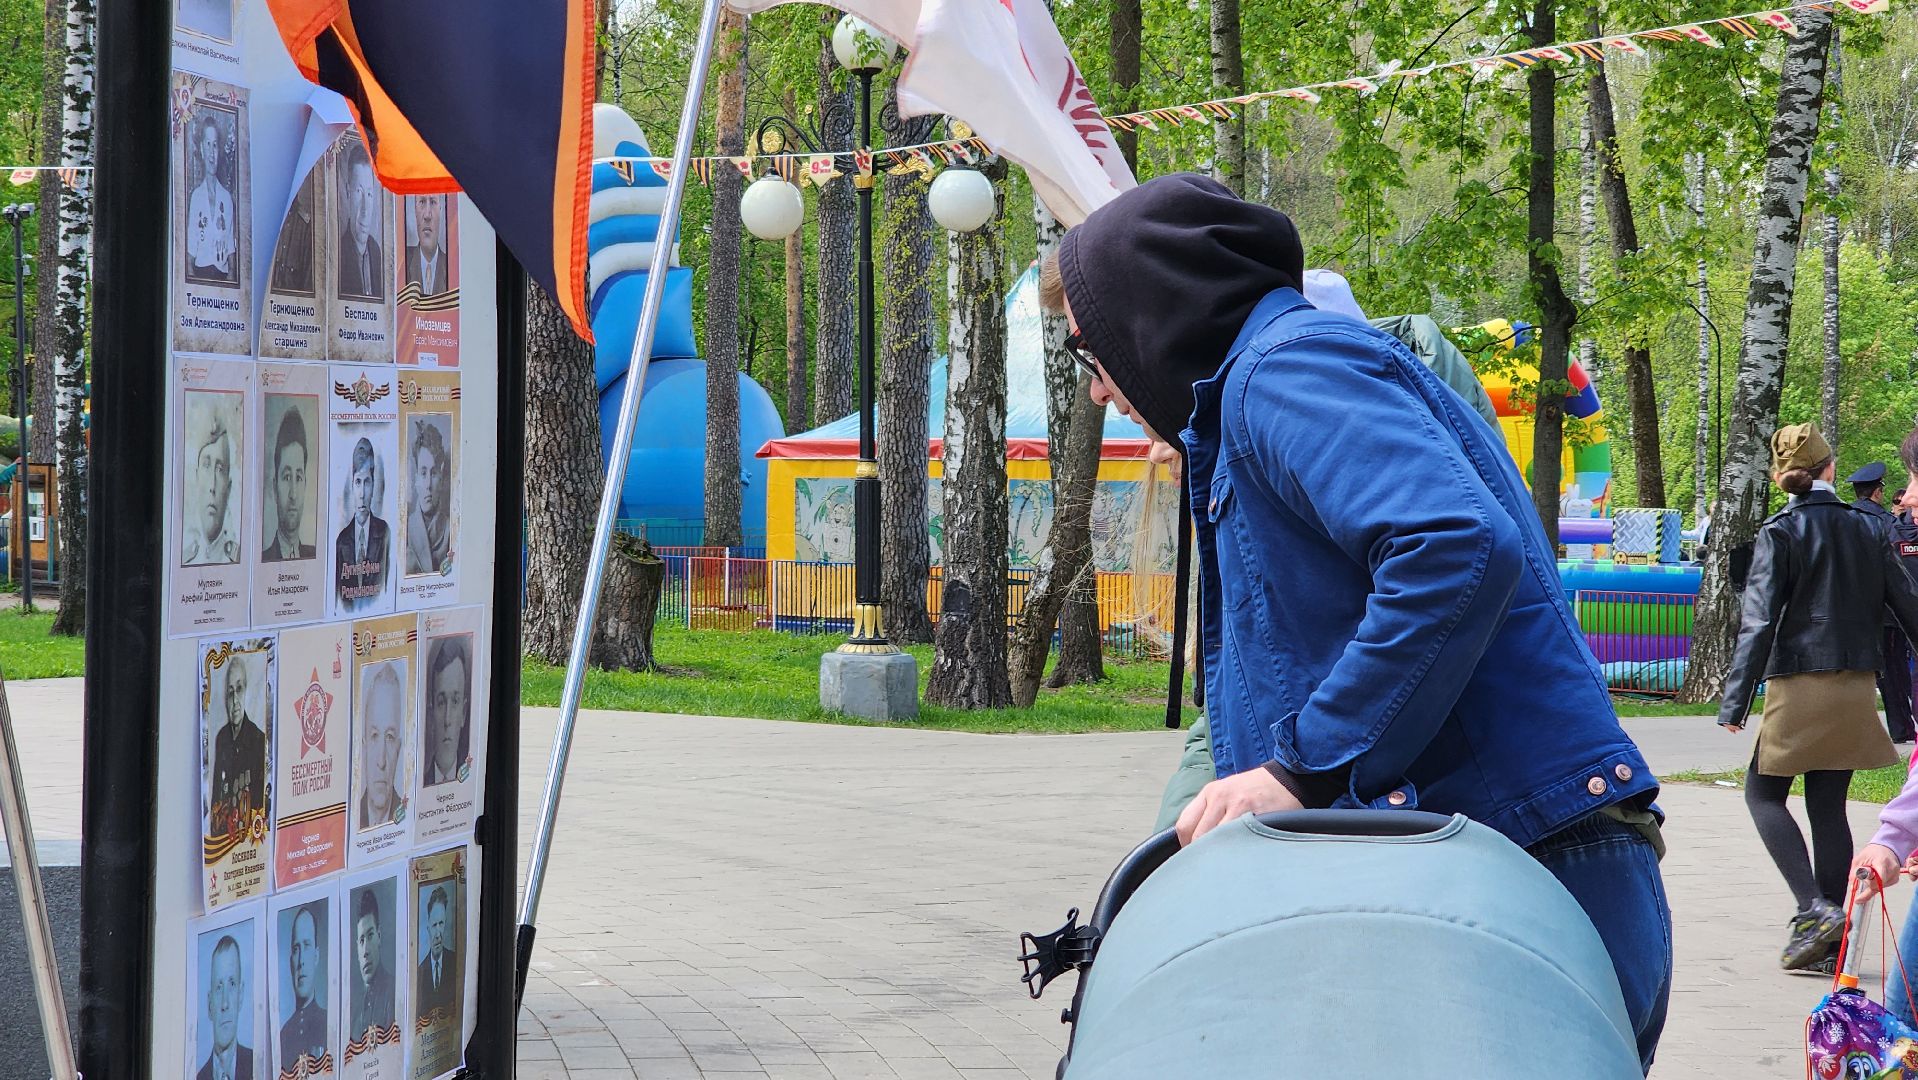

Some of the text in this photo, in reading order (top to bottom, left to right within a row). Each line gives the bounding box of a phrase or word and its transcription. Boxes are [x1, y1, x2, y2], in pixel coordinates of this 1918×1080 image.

[186, 292, 240, 311] Тернющенко
[270, 299, 315, 318] Тернющенко
[344, 305, 378, 321] Беспалов
[180, 315, 245, 332] Зоя Александровна
[415, 316, 452, 334] Иноземцев
[274, 337, 308, 349] старшина
[357, 329, 385, 341] Иванович
[291, 755, 333, 781] БЕССМЕРТНЫЙ
[292, 774, 331, 797] ПОЛК РОССИИ
[436, 793, 455, 804] Чернов
[302, 833, 320, 845] Чернов
